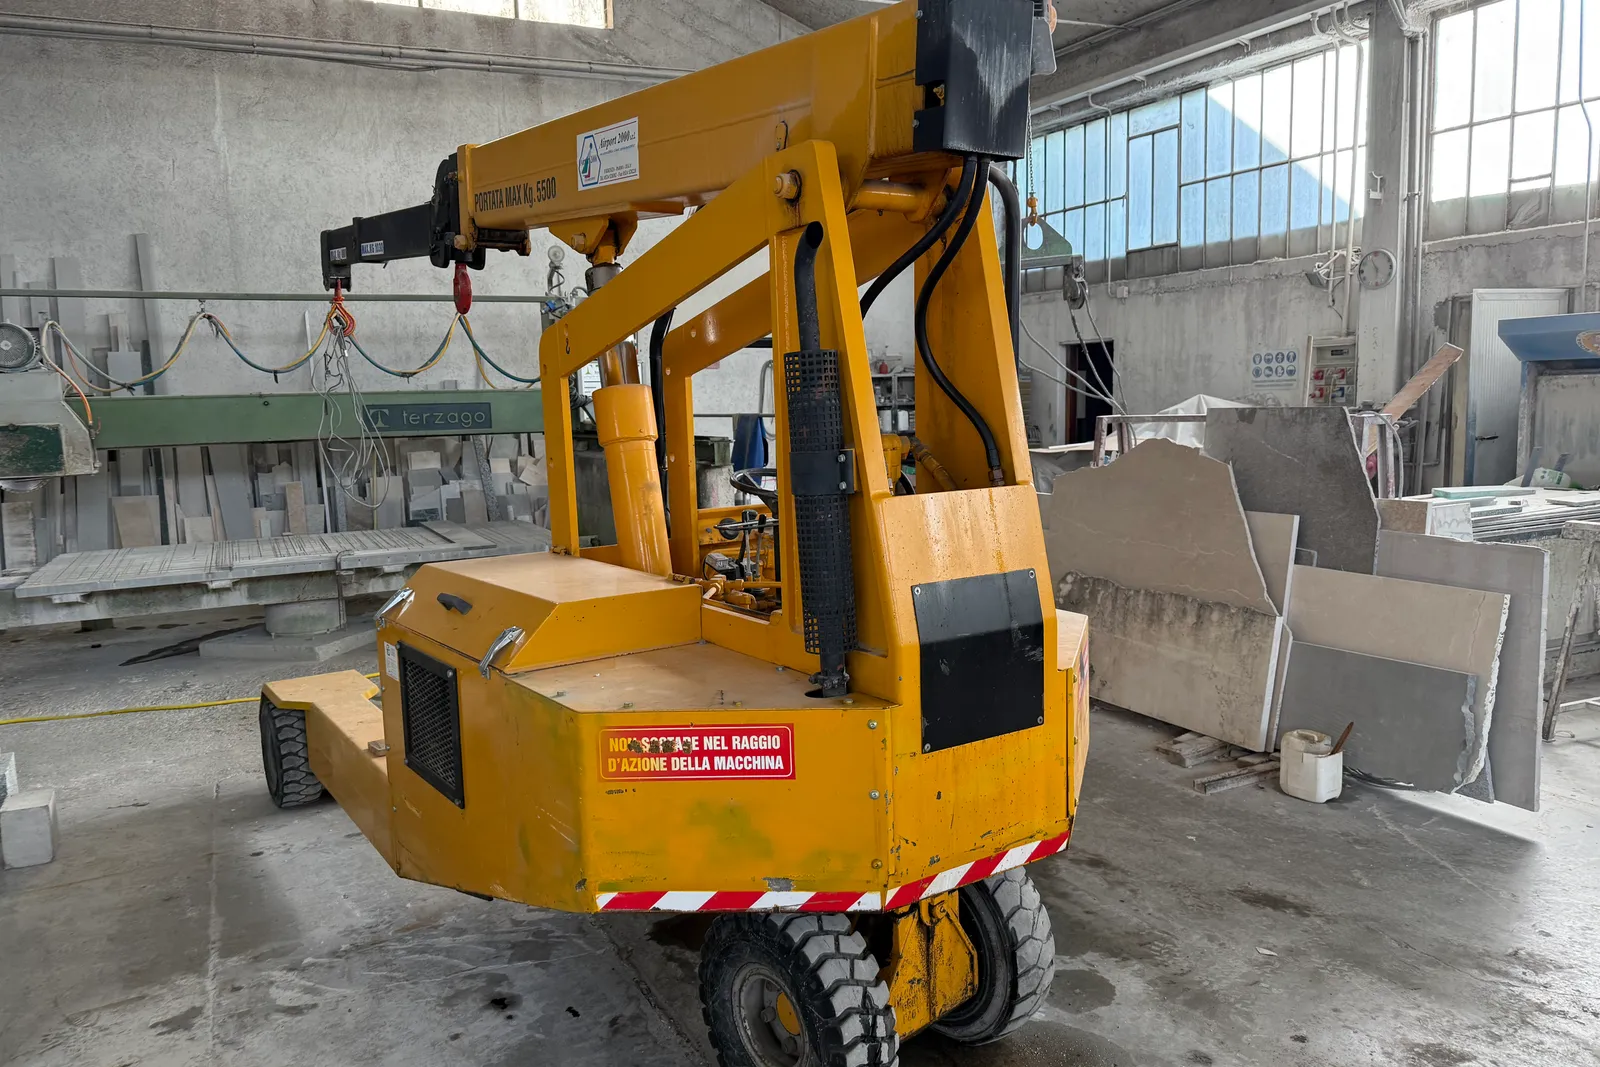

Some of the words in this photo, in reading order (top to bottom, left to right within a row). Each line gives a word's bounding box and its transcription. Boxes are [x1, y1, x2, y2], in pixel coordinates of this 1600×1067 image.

[599, 136, 617, 150] Airport
[617, 130, 631, 144] 2000
[474, 188, 504, 213] PORTATA
[505, 184, 522, 207] MAX
[536, 176, 557, 202] 5500
[403, 410, 486, 427] terzago
[703, 735, 729, 751] NEL
[732, 735, 781, 750] RAGGIO
[608, 757, 667, 773] D'AZIONE
[671, 756, 711, 771] DELLA
[714, 755, 784, 770] MACCHINA
